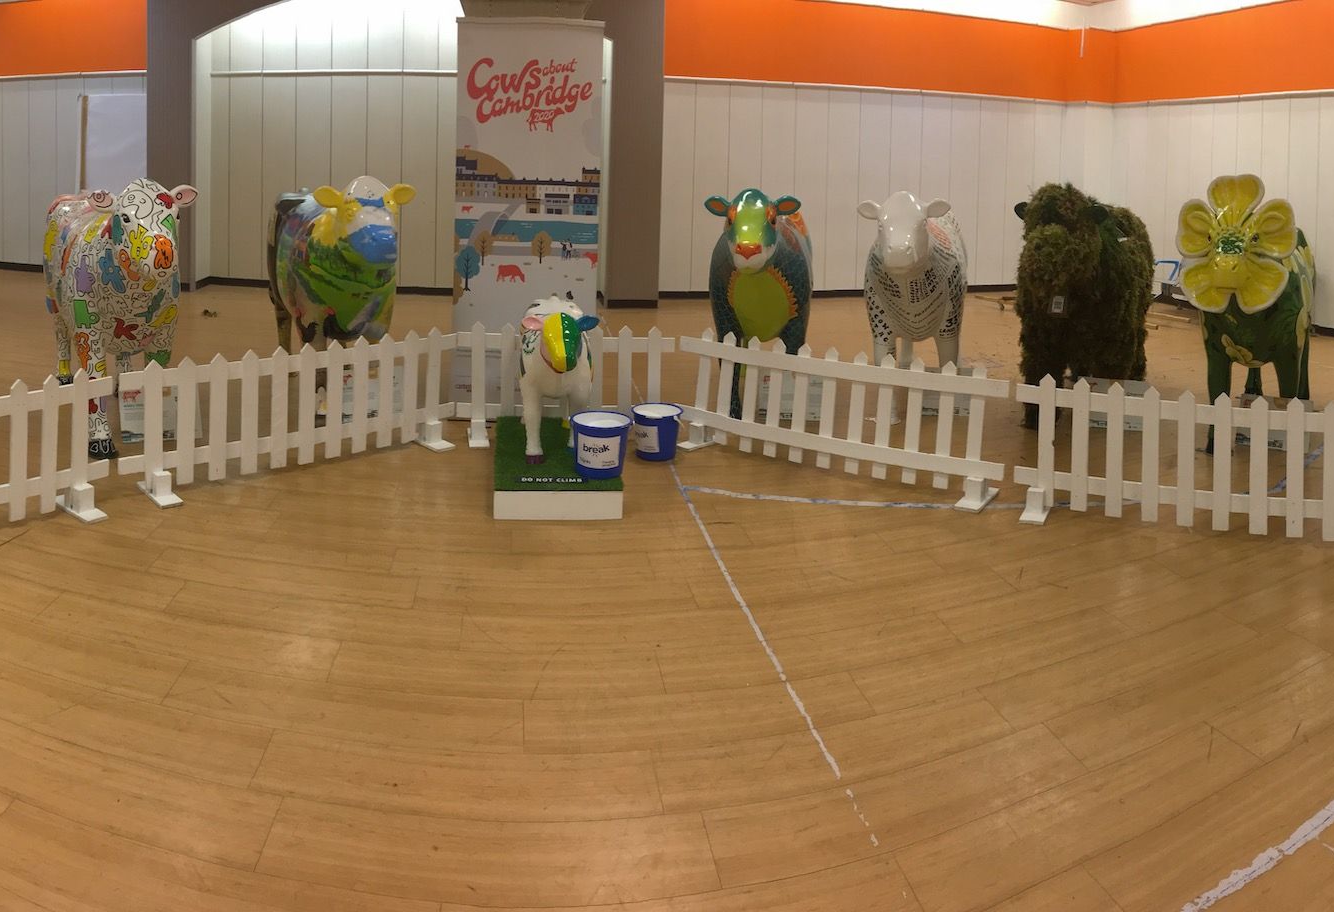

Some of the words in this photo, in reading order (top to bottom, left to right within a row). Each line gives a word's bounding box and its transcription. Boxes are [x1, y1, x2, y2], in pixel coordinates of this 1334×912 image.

[467, 58, 542, 101] Cows
[542, 58, 577, 76] about
[476, 75, 593, 124] Cambridge
[534, 111, 555, 121] 2020
[583, 443, 610, 454] break
